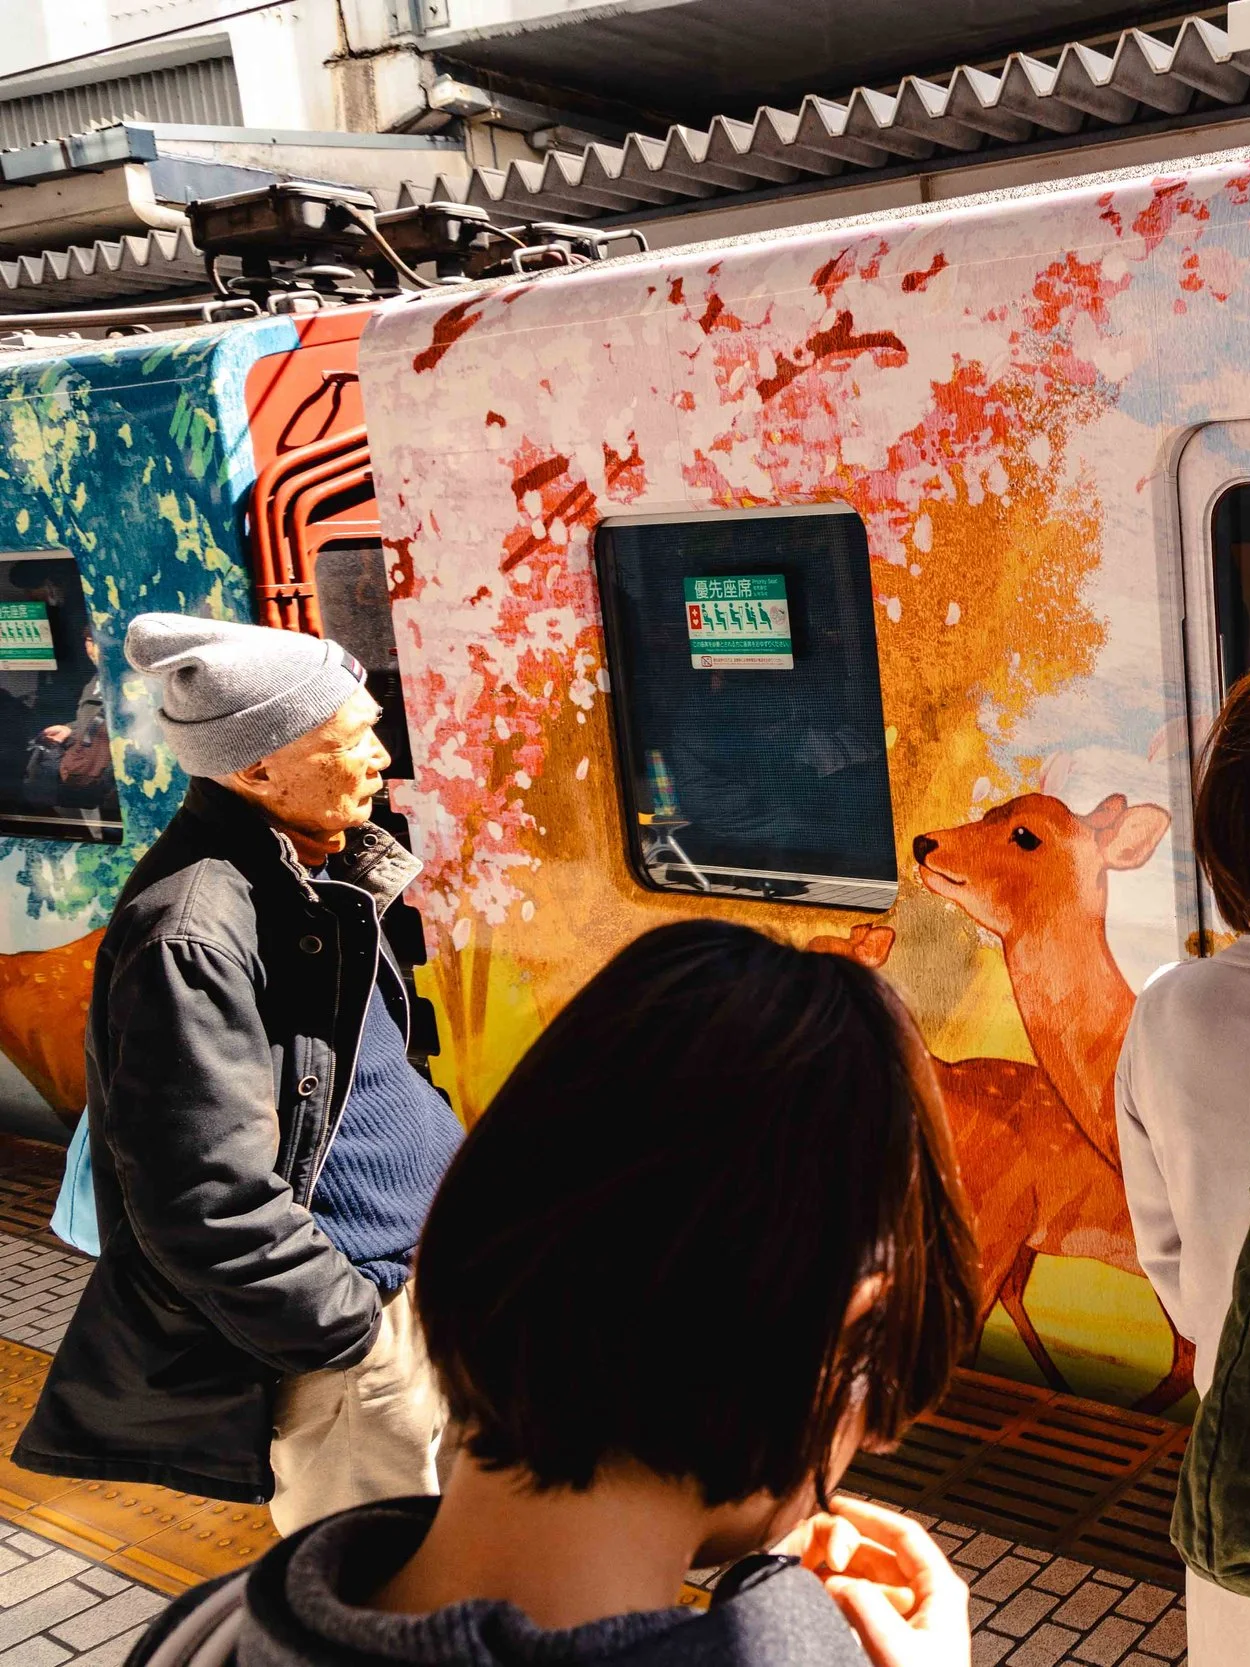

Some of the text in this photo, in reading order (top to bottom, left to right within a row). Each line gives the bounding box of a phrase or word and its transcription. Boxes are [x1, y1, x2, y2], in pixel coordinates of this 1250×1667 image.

[695, 579, 752, 598] 優先座席
[0, 605, 27, 619] 先座席
